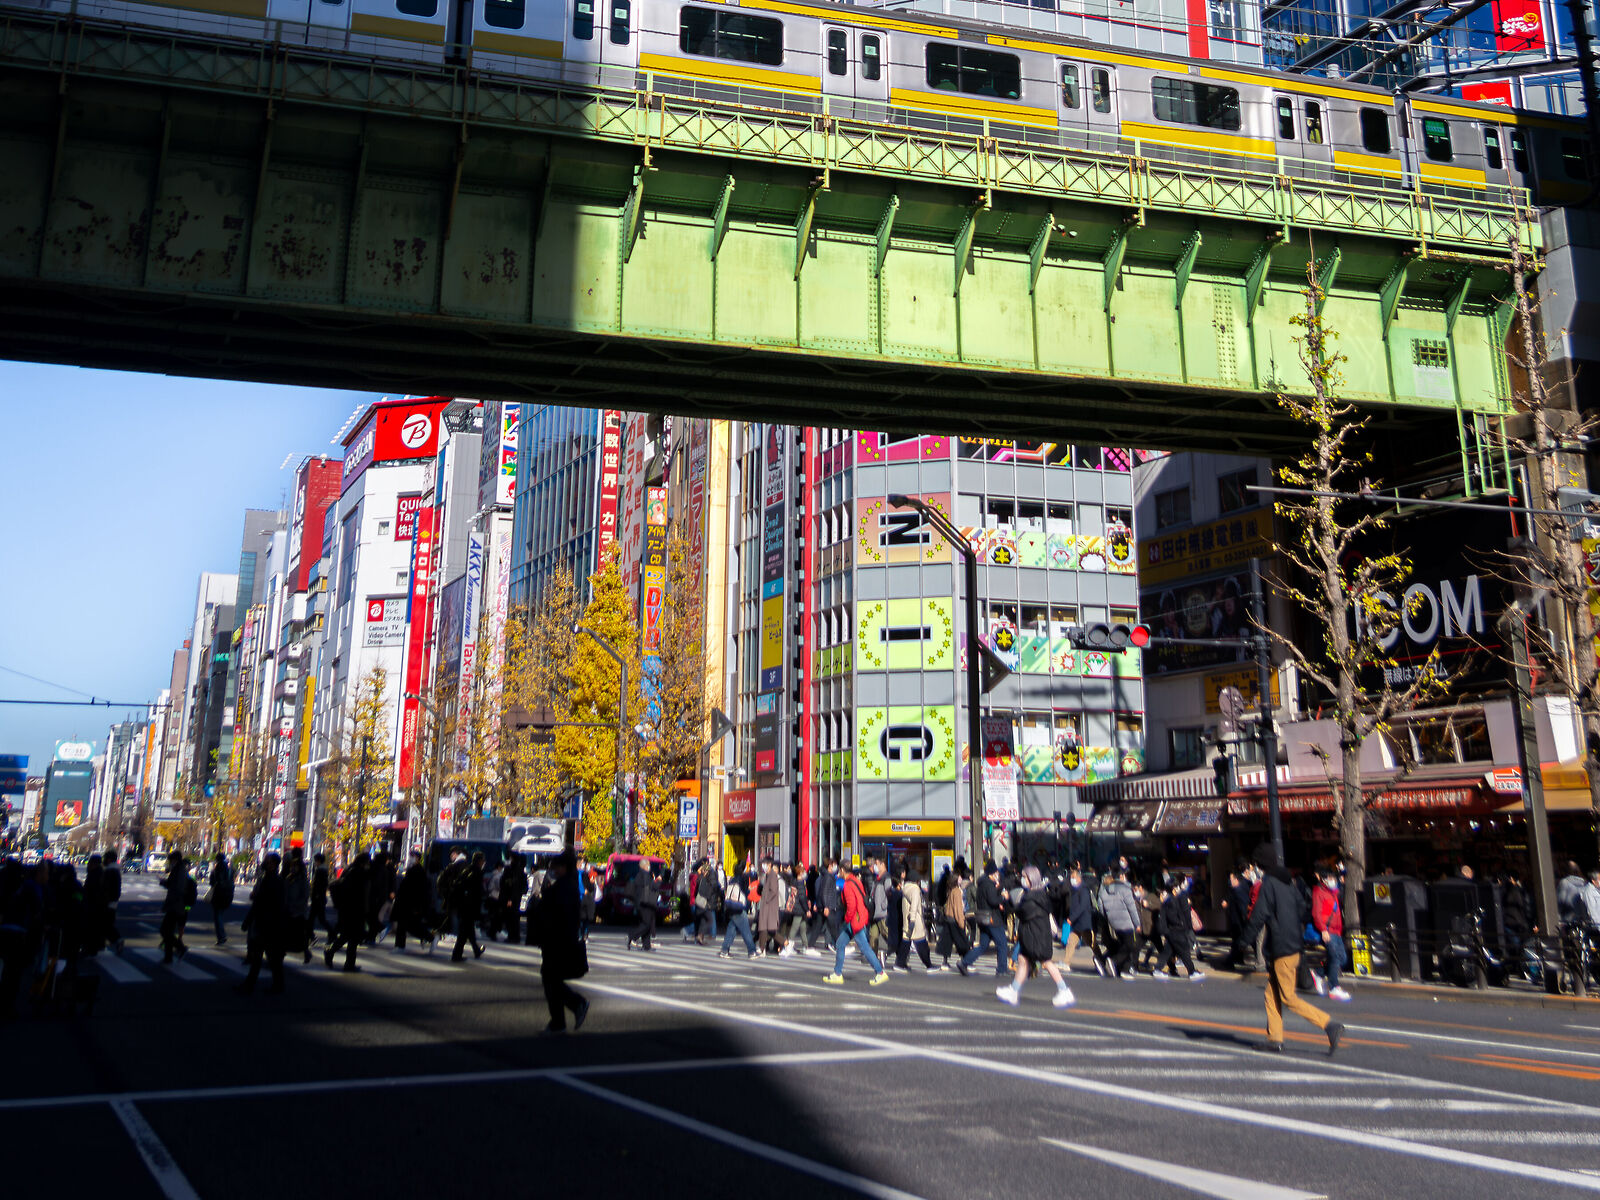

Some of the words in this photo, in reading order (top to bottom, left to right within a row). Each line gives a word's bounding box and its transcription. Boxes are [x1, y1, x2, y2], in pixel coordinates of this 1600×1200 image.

[647, 540, 665, 550] アニメ
[468, 537, 482, 587] AKKY
[650, 554, 662, 565] CD
[645, 586, 662, 651] DVD
[368, 624, 389, 632] Camera
[460, 641, 476, 699] Tax-free
[769, 671, 777, 684] 3F
[683, 801, 695, 815] P
[728, 798, 751, 813] Rakuten
[680, 824, 689, 833] IN
